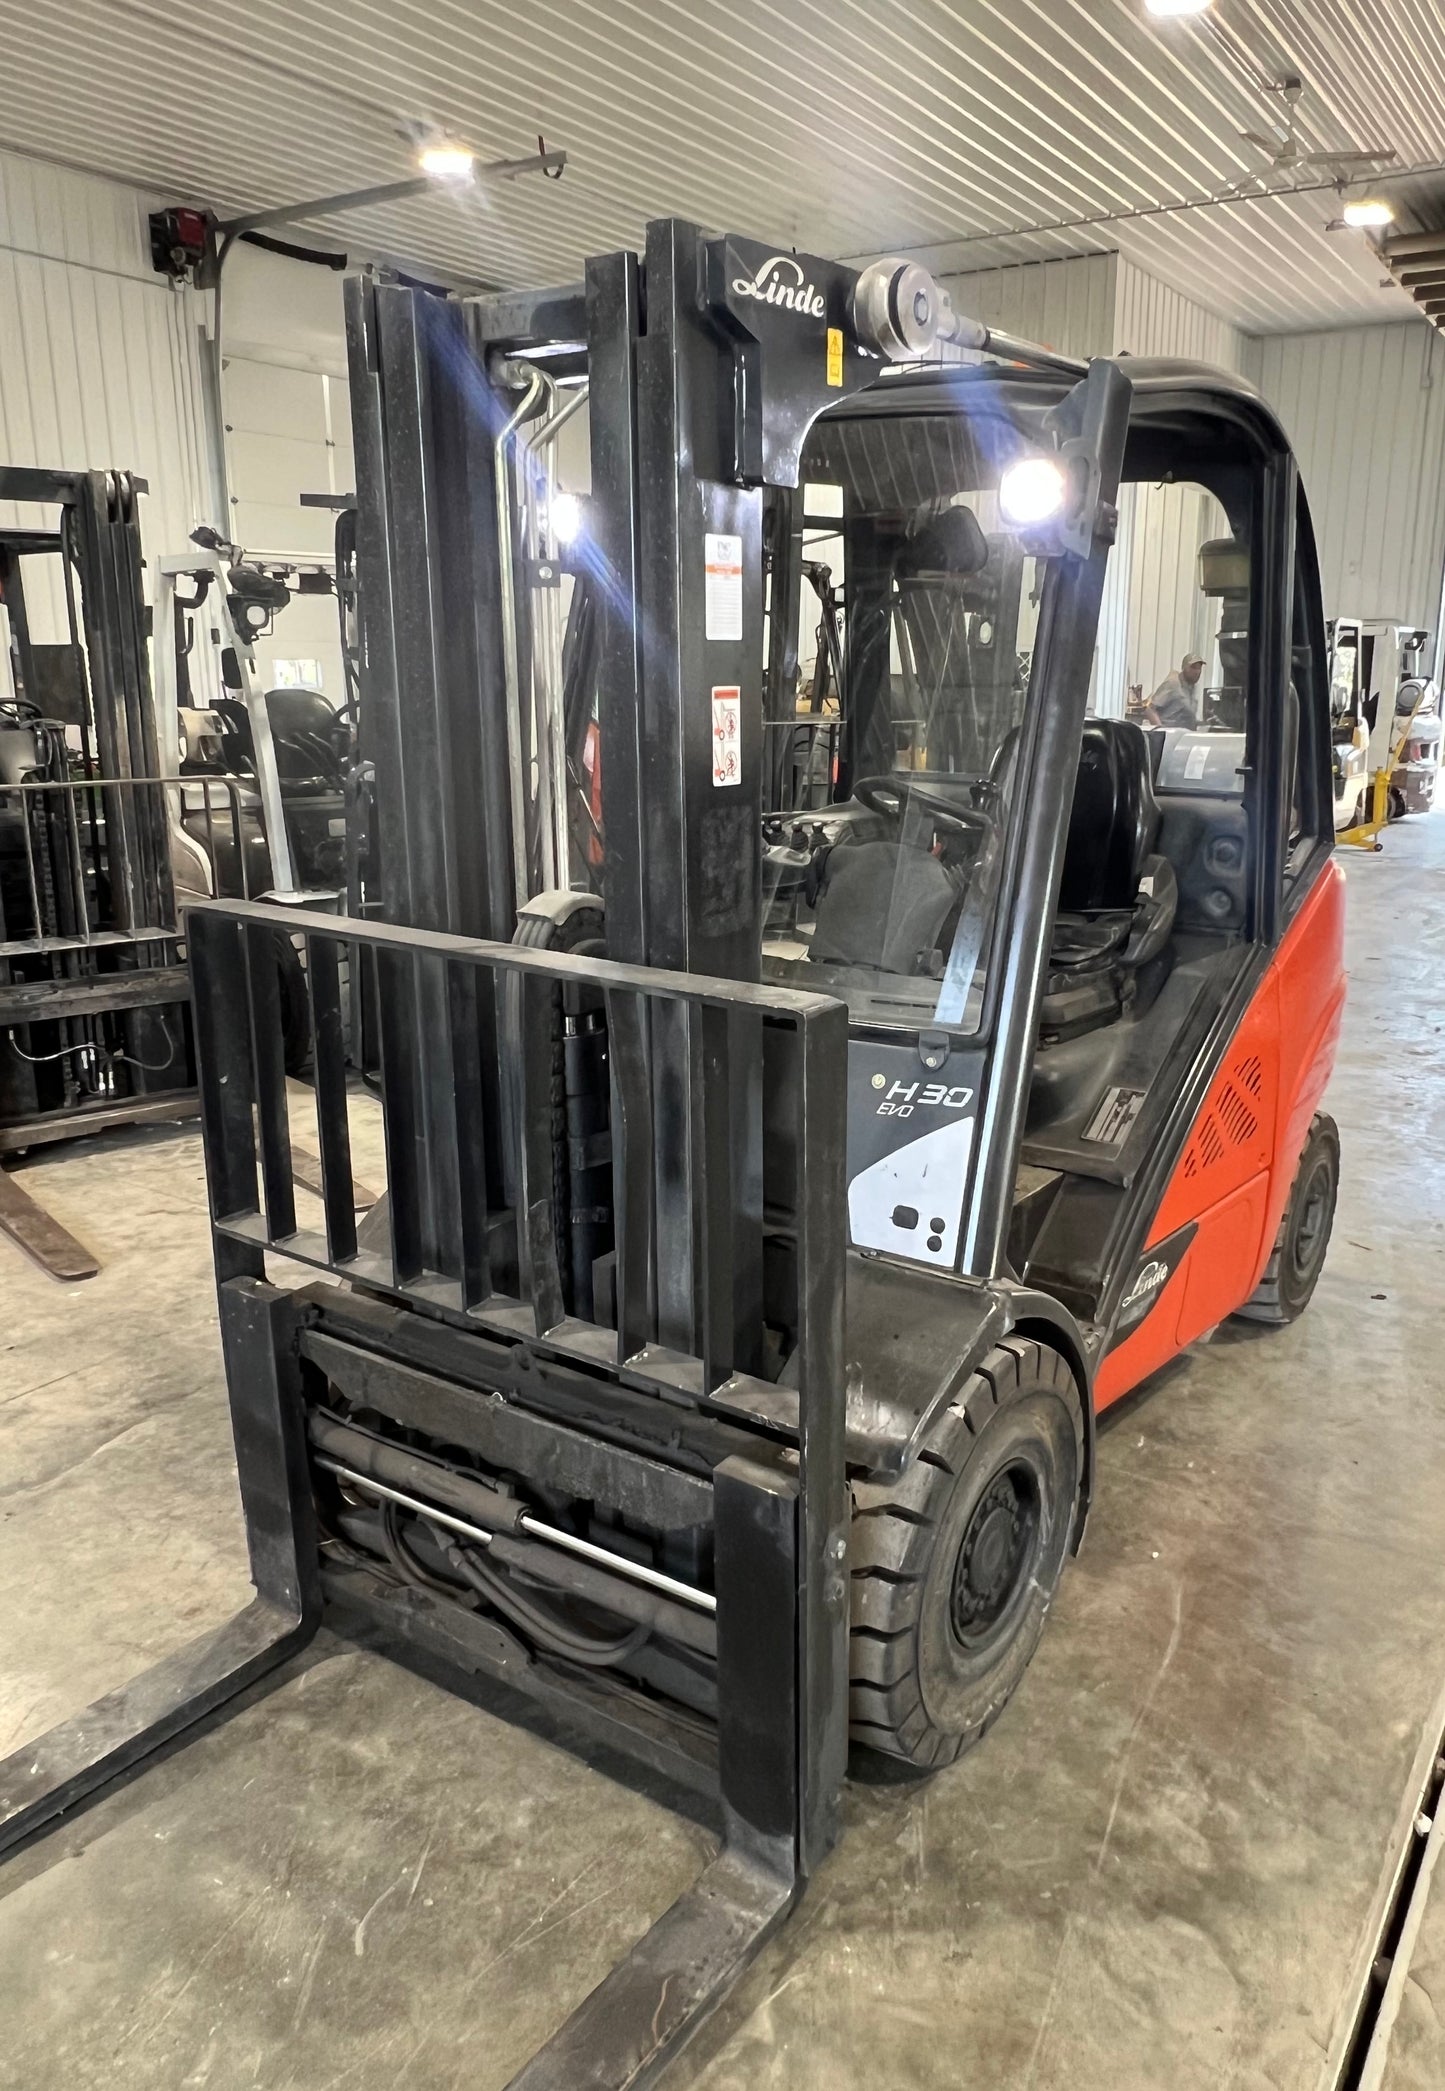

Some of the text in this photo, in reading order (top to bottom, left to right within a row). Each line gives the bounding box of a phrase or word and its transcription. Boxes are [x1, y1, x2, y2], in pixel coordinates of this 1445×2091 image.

[732, 256, 825, 318] Linde
[885, 1080, 974, 1108] H 30
[876, 1102, 915, 1118] EVO
